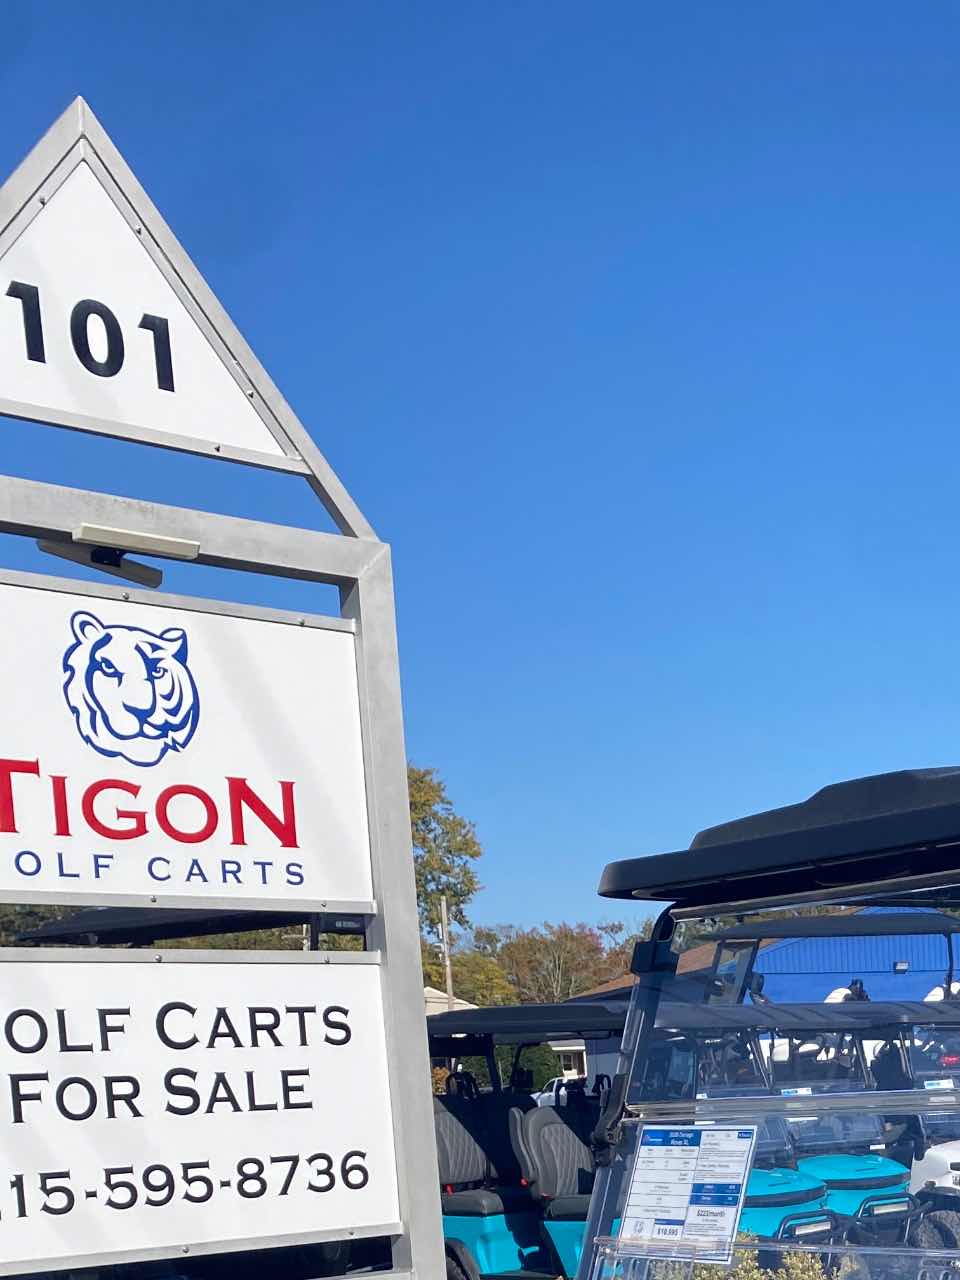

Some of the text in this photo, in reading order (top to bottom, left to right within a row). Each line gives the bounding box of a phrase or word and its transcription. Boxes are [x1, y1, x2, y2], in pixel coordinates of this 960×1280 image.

[6, 280, 176, 393] 101
[0, 758, 299, 849] TIGON
[15, 850, 306, 886] OLF CARTS
[4, 1001, 352, 1054] OLF CARTS
[8, 1067, 314, 1124] FOR SALE
[0, 1150, 370, 1220] 15-595-8736
